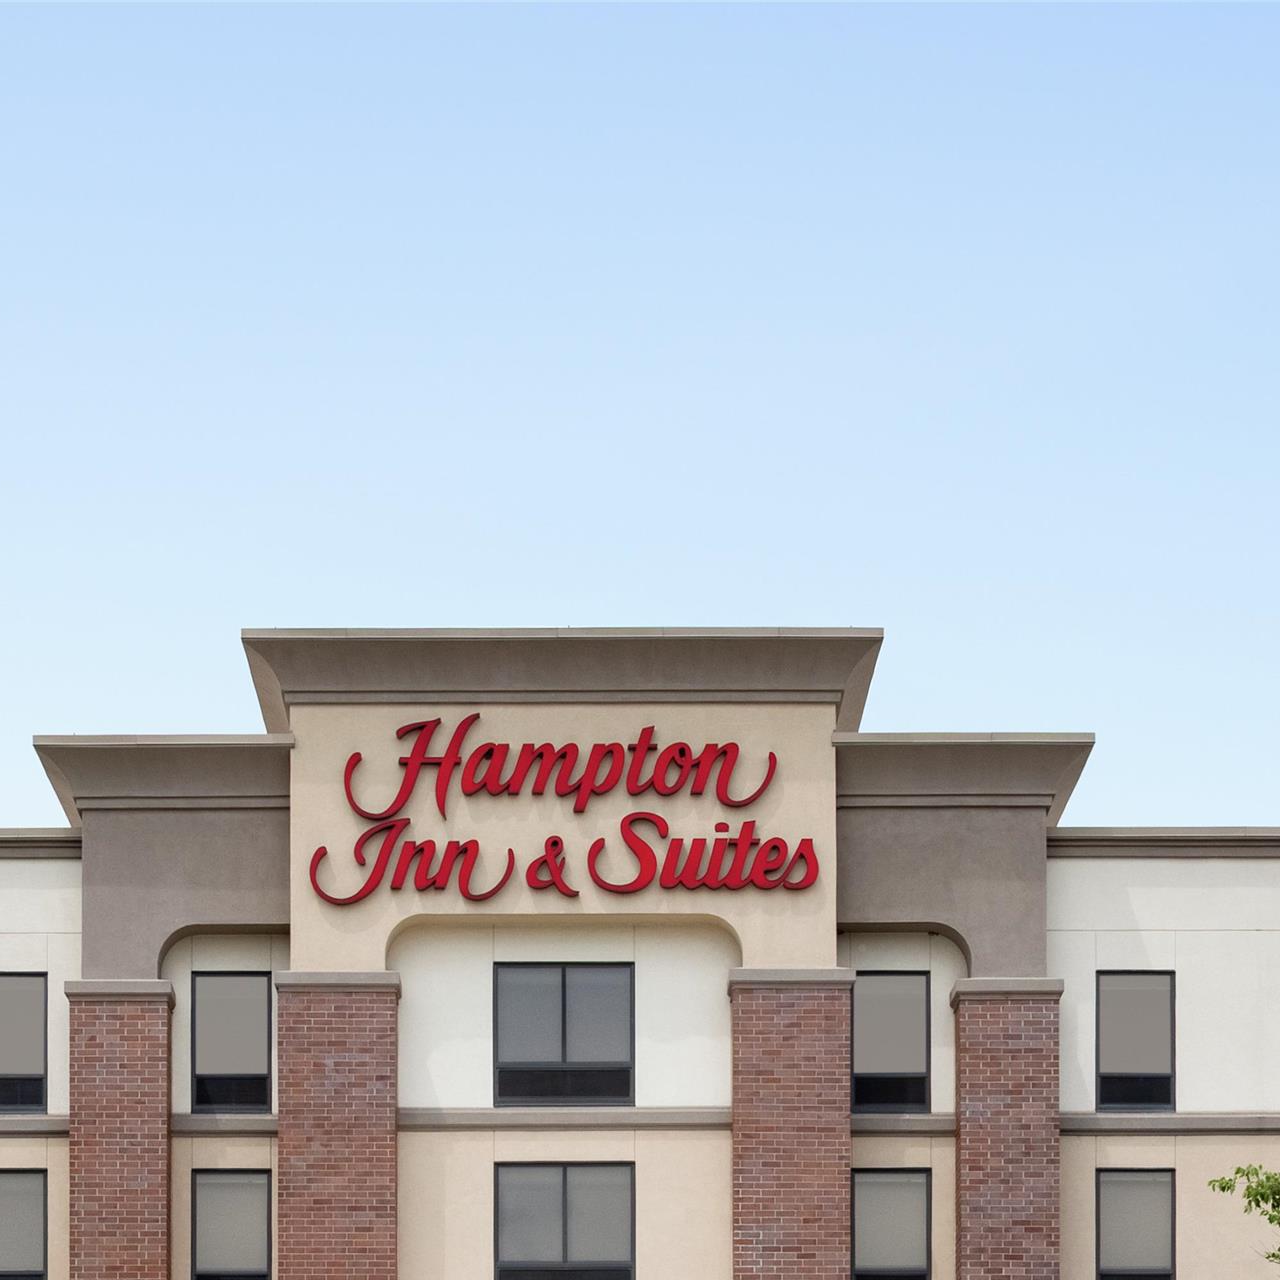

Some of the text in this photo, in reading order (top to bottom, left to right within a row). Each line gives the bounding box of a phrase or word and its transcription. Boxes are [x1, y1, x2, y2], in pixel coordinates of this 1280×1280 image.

[343, 712, 777, 821] Hampton
[309, 811, 820, 906] Inn & Suites
